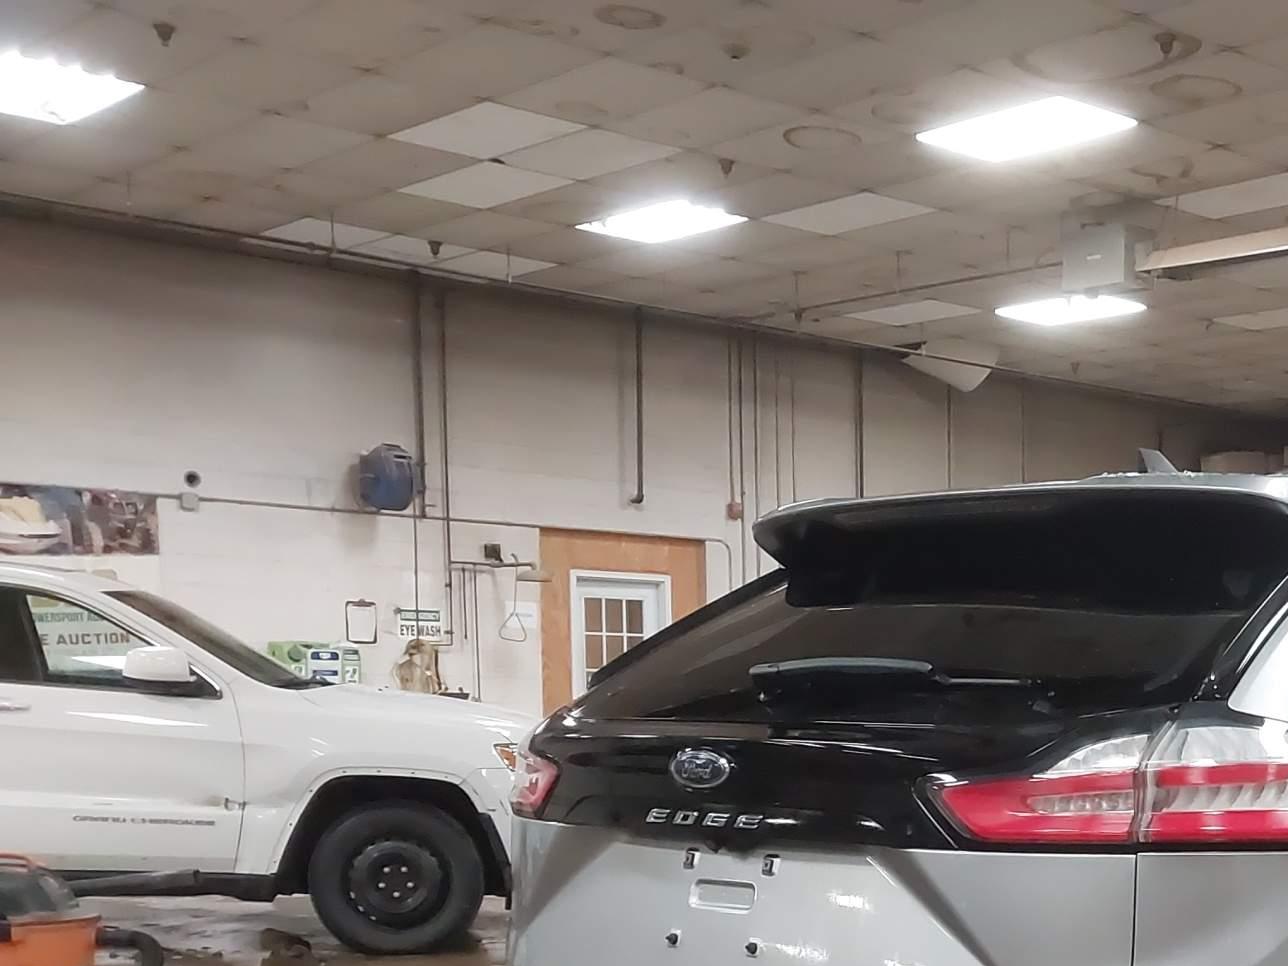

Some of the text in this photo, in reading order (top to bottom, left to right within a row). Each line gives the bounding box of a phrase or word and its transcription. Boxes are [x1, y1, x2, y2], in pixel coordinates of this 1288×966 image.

[400, 624, 441, 637] EYE WASH
[56, 632, 130, 646] AUCTION
[645, 808, 763, 829] EDGE
